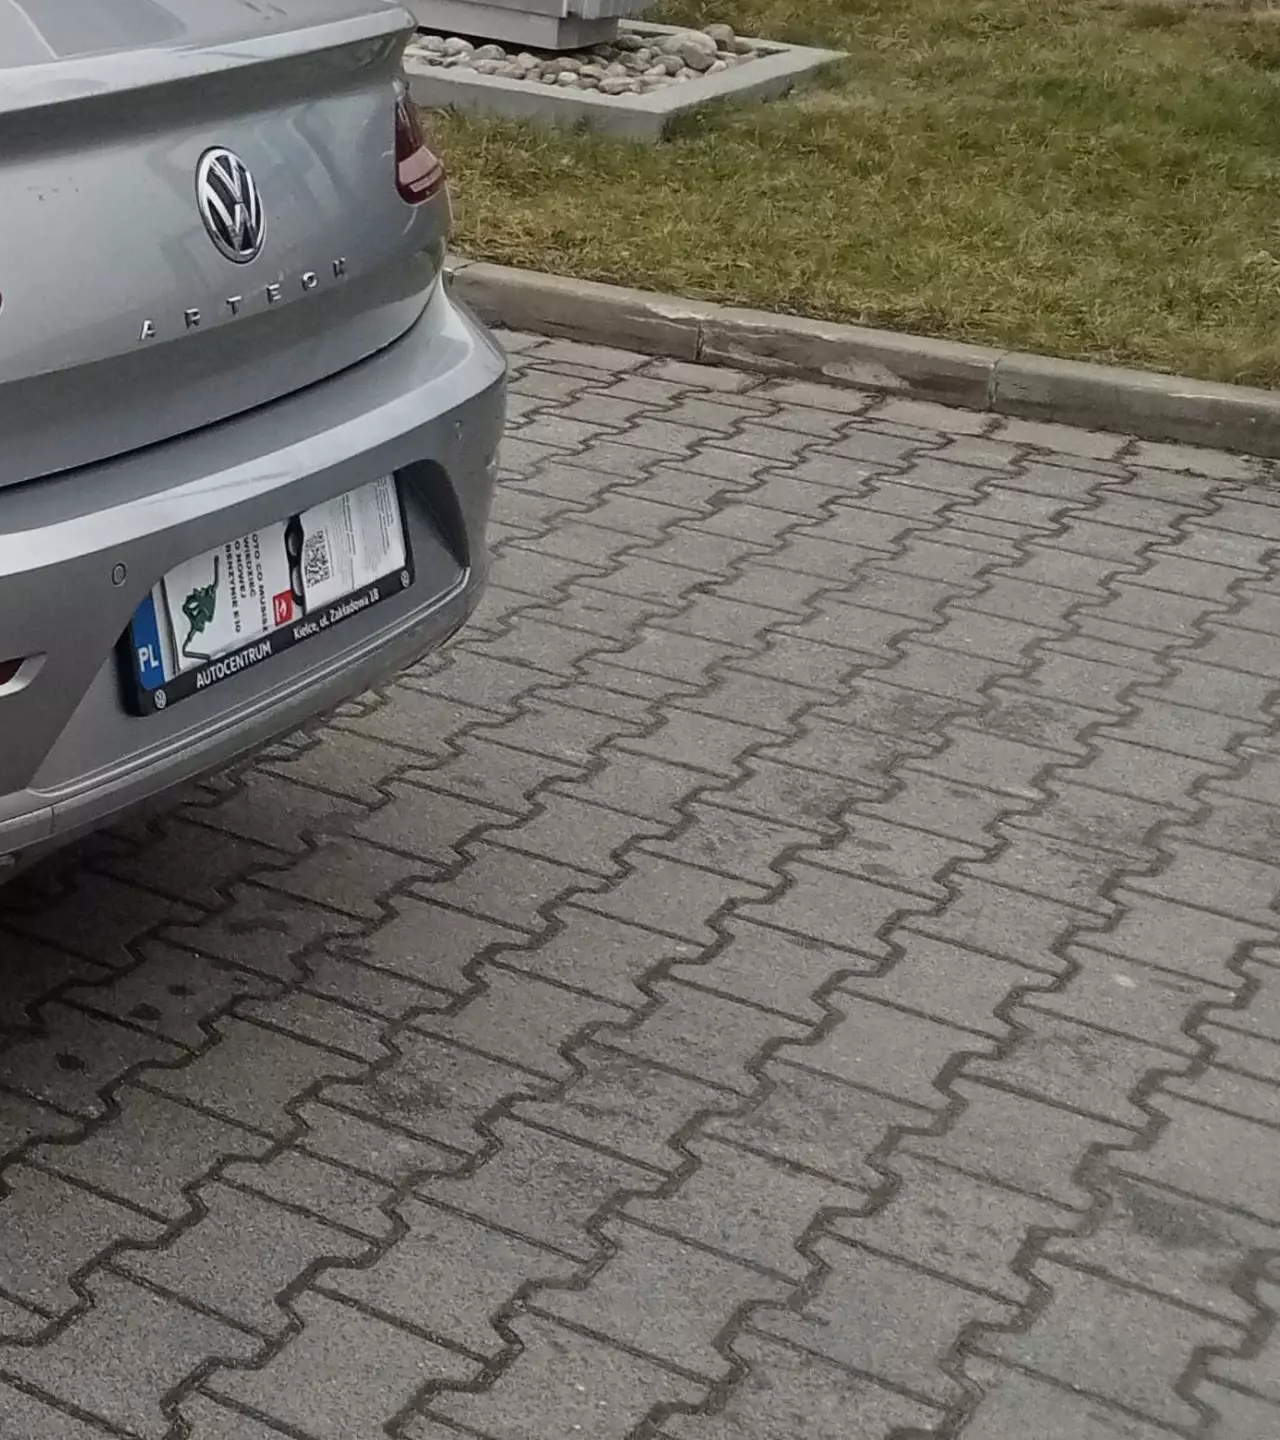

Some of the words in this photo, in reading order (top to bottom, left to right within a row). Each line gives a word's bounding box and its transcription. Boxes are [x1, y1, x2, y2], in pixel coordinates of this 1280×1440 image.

[139, 256, 347, 341] ARTEON
[138, 643, 159, 673] PL
[196, 640, 272, 689] AUTOCENTRUM
